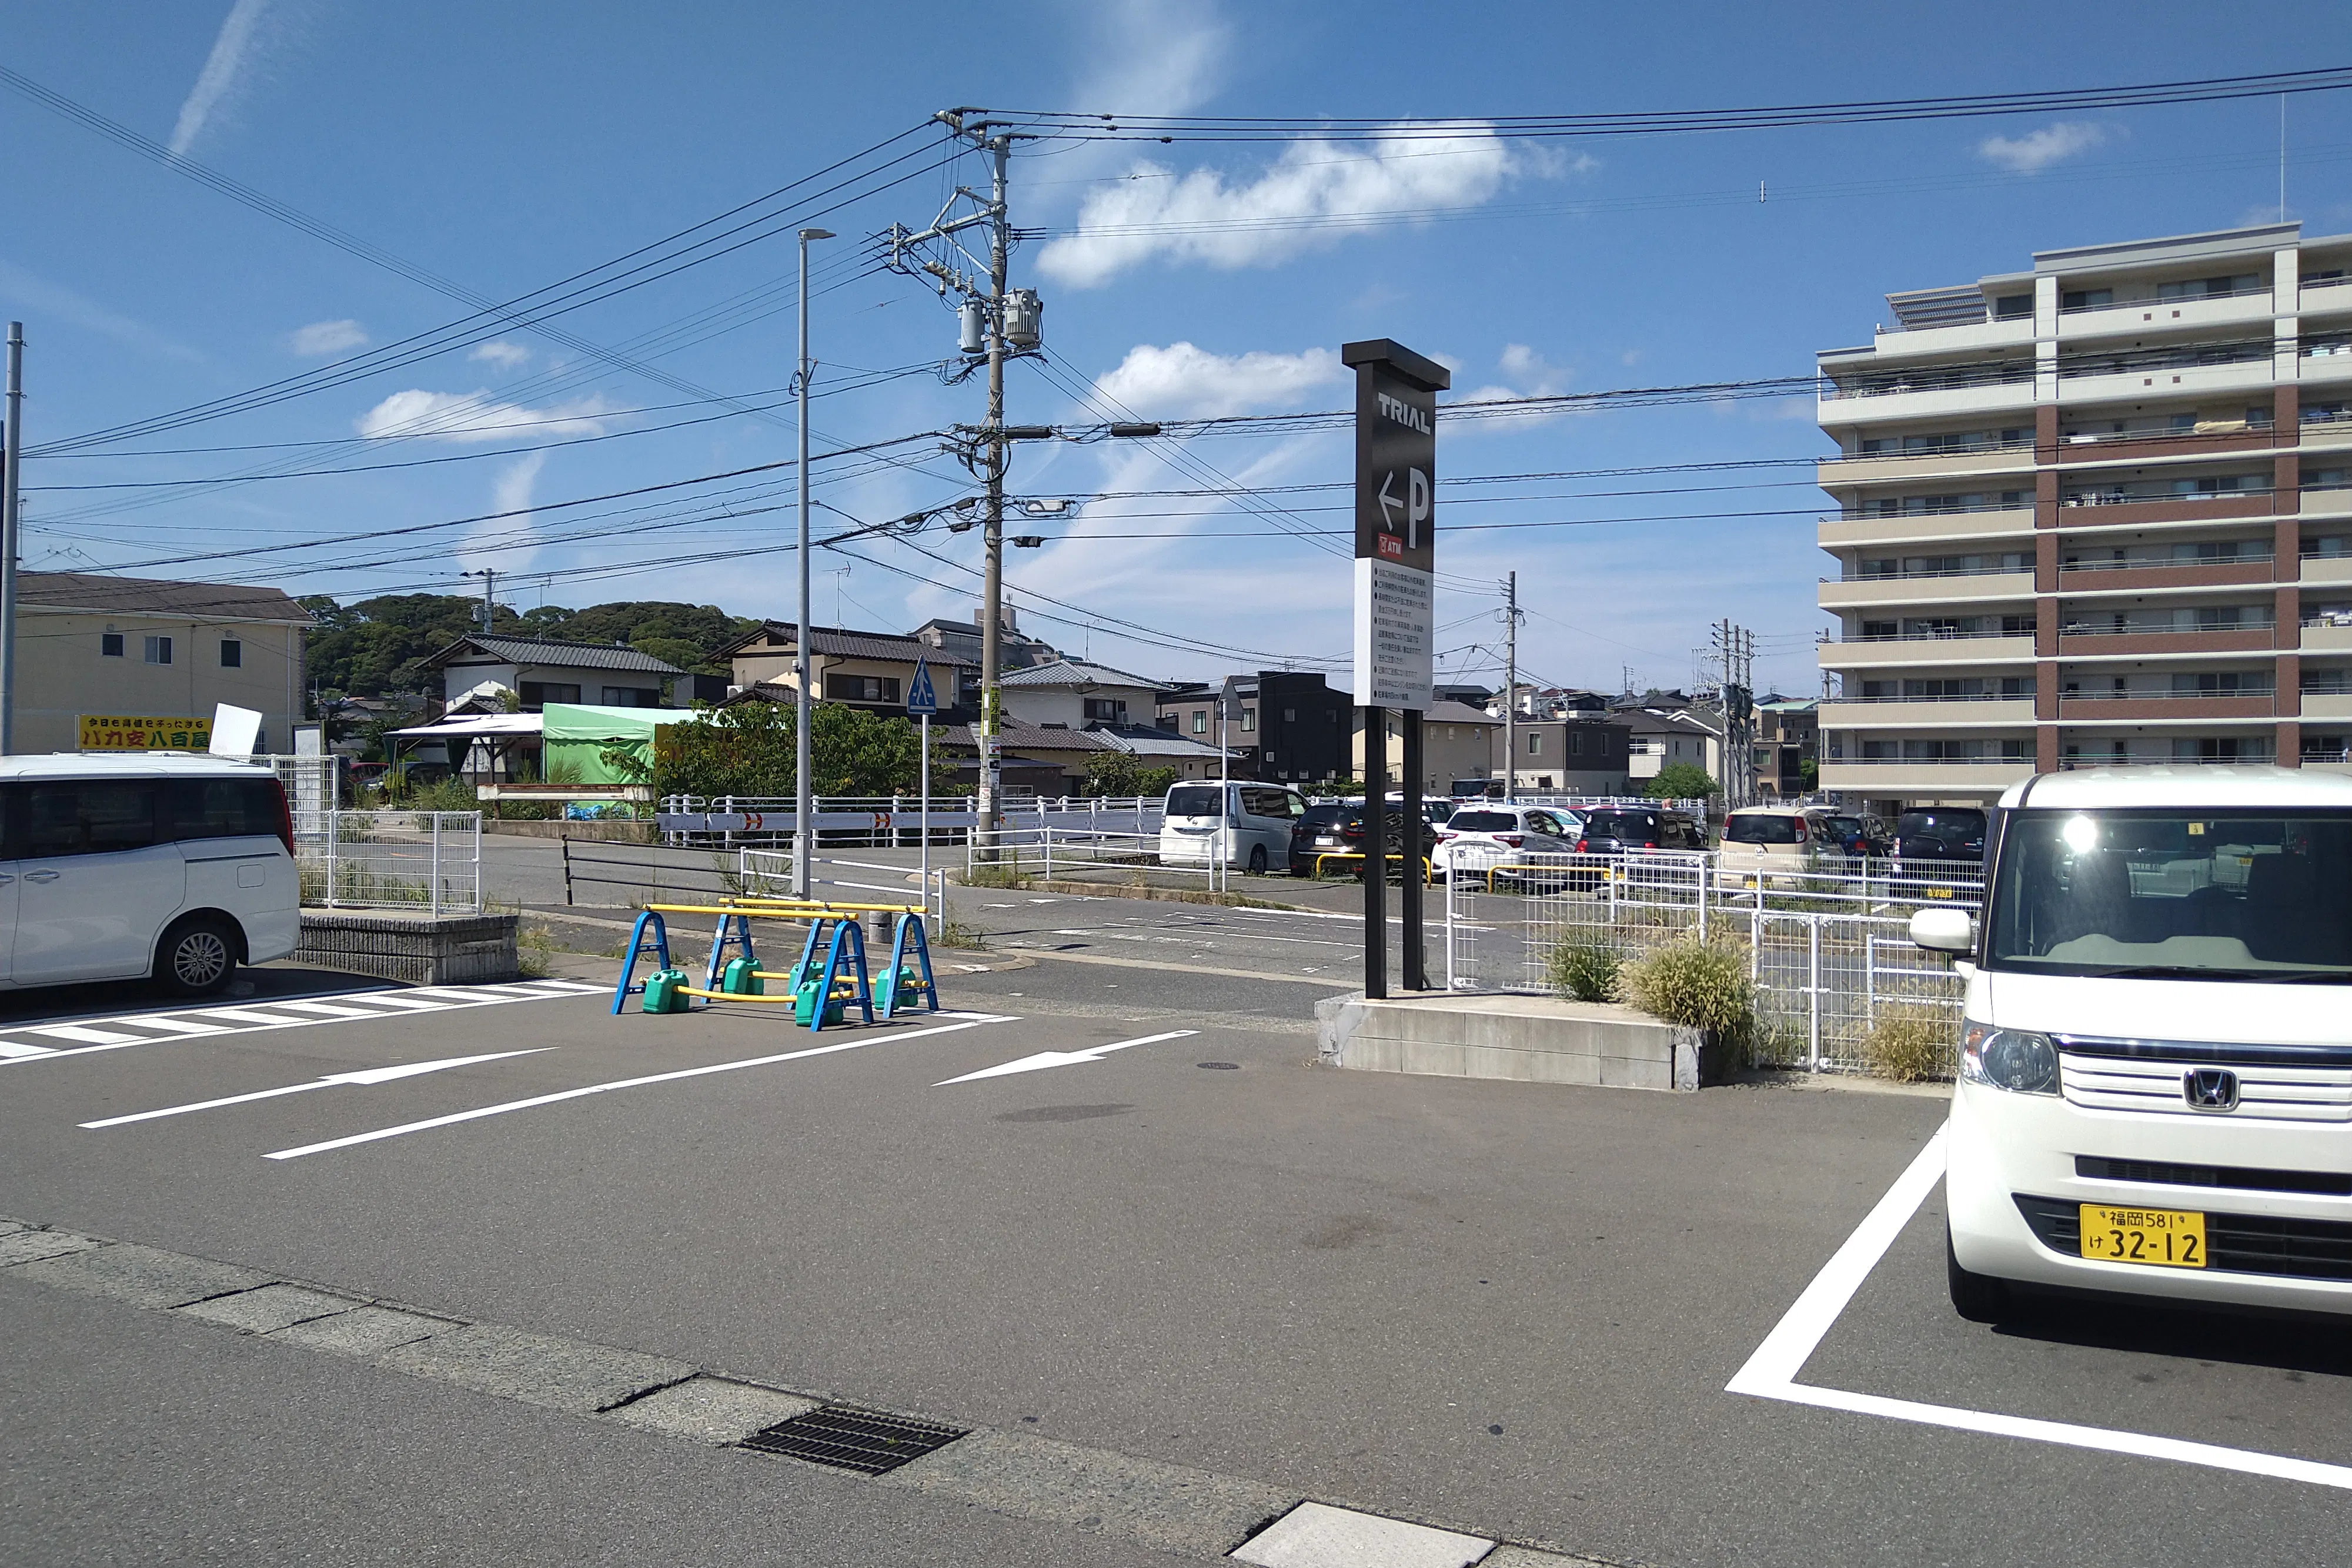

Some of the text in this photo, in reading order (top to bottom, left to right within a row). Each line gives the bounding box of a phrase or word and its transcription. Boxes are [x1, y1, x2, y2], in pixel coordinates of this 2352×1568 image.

[1378, 392, 1431, 435] TRIAL
[1409, 467, 1429, 549] P
[1388, 541, 1401, 554] ATM
[990, 692, 1000, 735] 吉永眼科
[2089, 1235, 2103, 1249] け
[2109, 1229, 2199, 1263] 32-12
